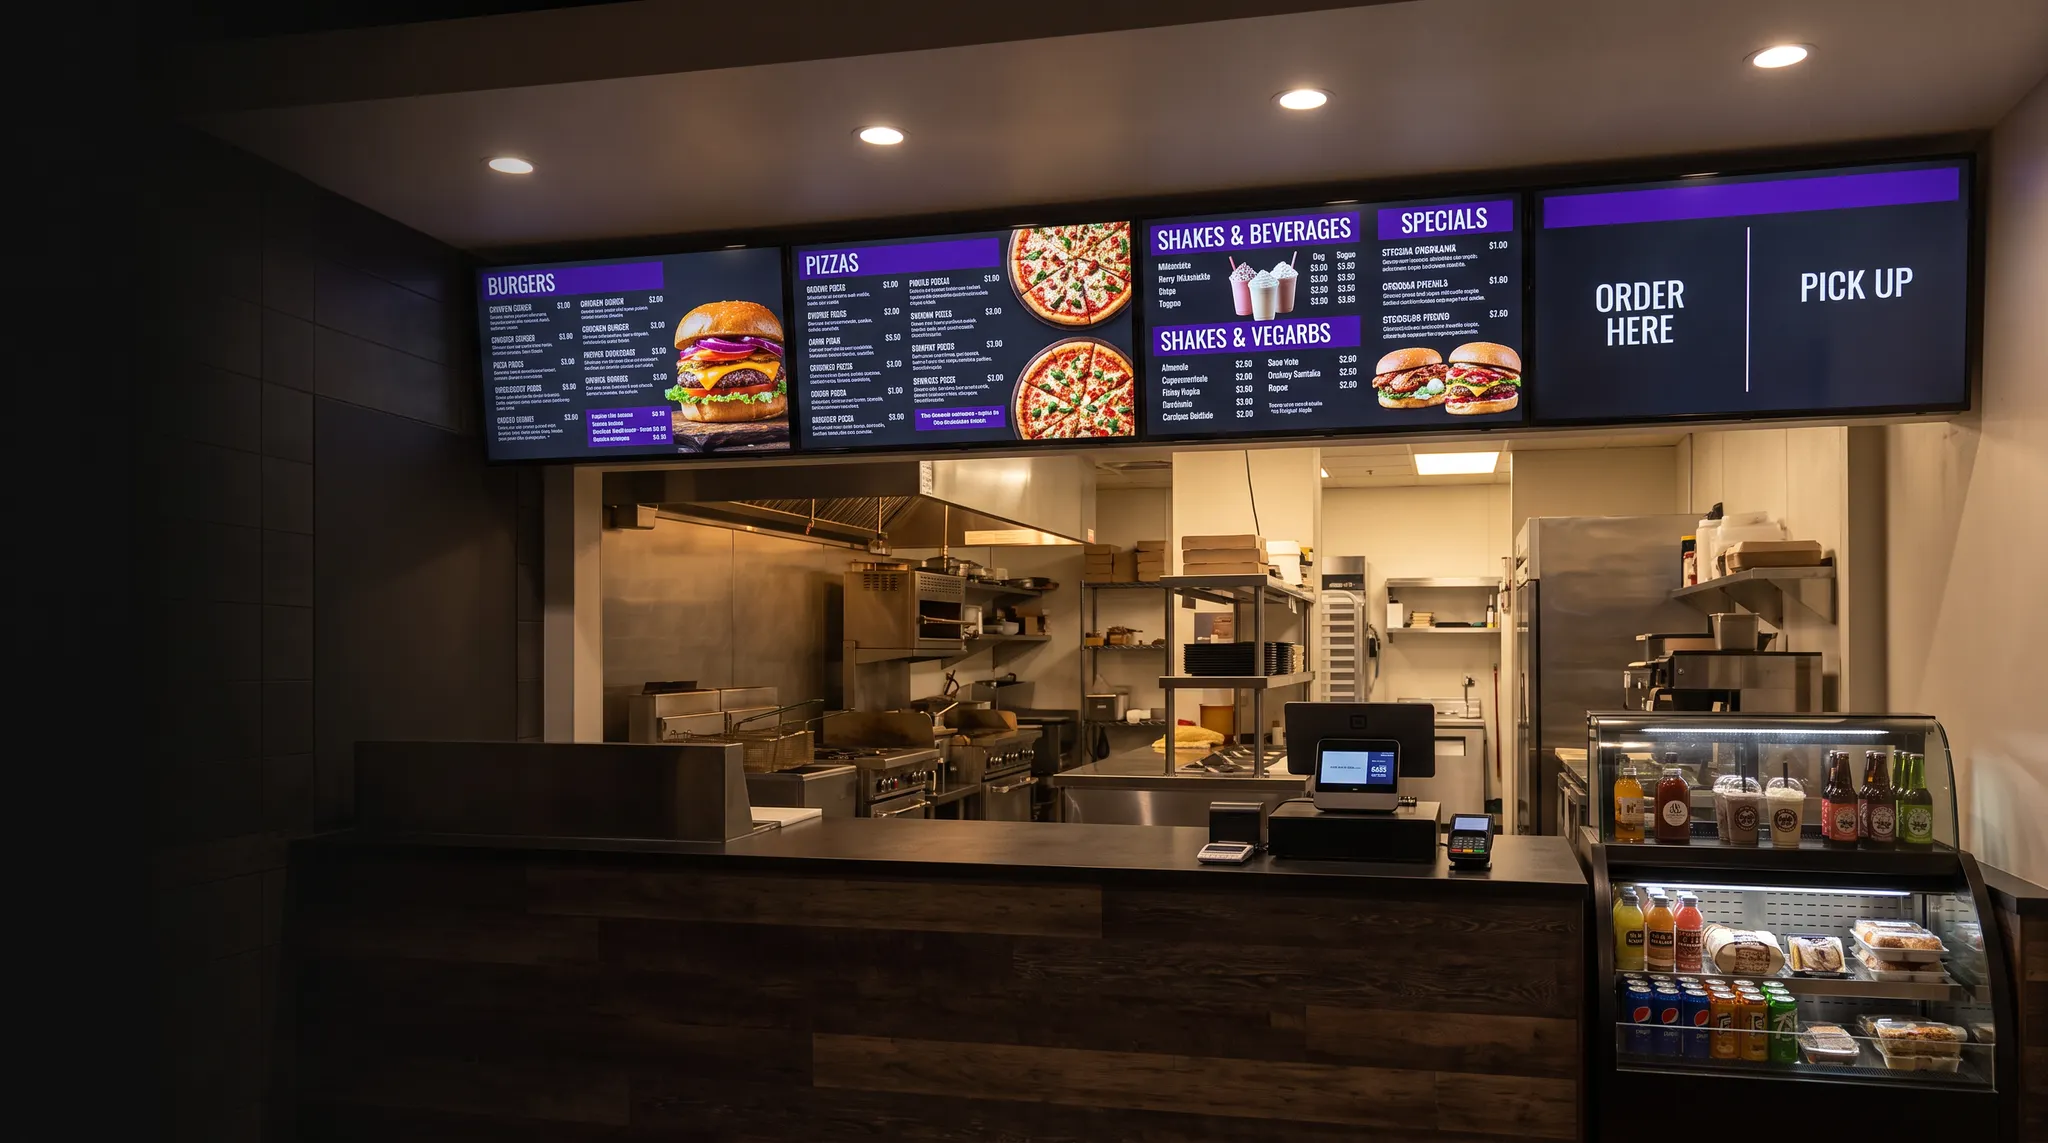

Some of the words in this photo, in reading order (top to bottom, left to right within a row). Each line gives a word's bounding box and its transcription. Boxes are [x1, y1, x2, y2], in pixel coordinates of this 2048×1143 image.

[1158, 226, 1225, 251] SHAKES
[1230, 225, 1244, 246] &
[1250, 217, 1351, 245] BEVERAGES
[1401, 207, 1488, 234] SPECIALS
[806, 253, 859, 275] PIZZAS
[488, 273, 556, 296] BURGERS
[1595, 279, 1685, 313] ORDER
[1800, 269, 1866, 303] PICK
[1875, 267, 1913, 299] UP
[1160, 327, 1227, 351] SHAKES
[1233, 326, 1246, 348] &
[1251, 322, 1331, 347] VEGARBS
[1607, 314, 1674, 346] HERE
